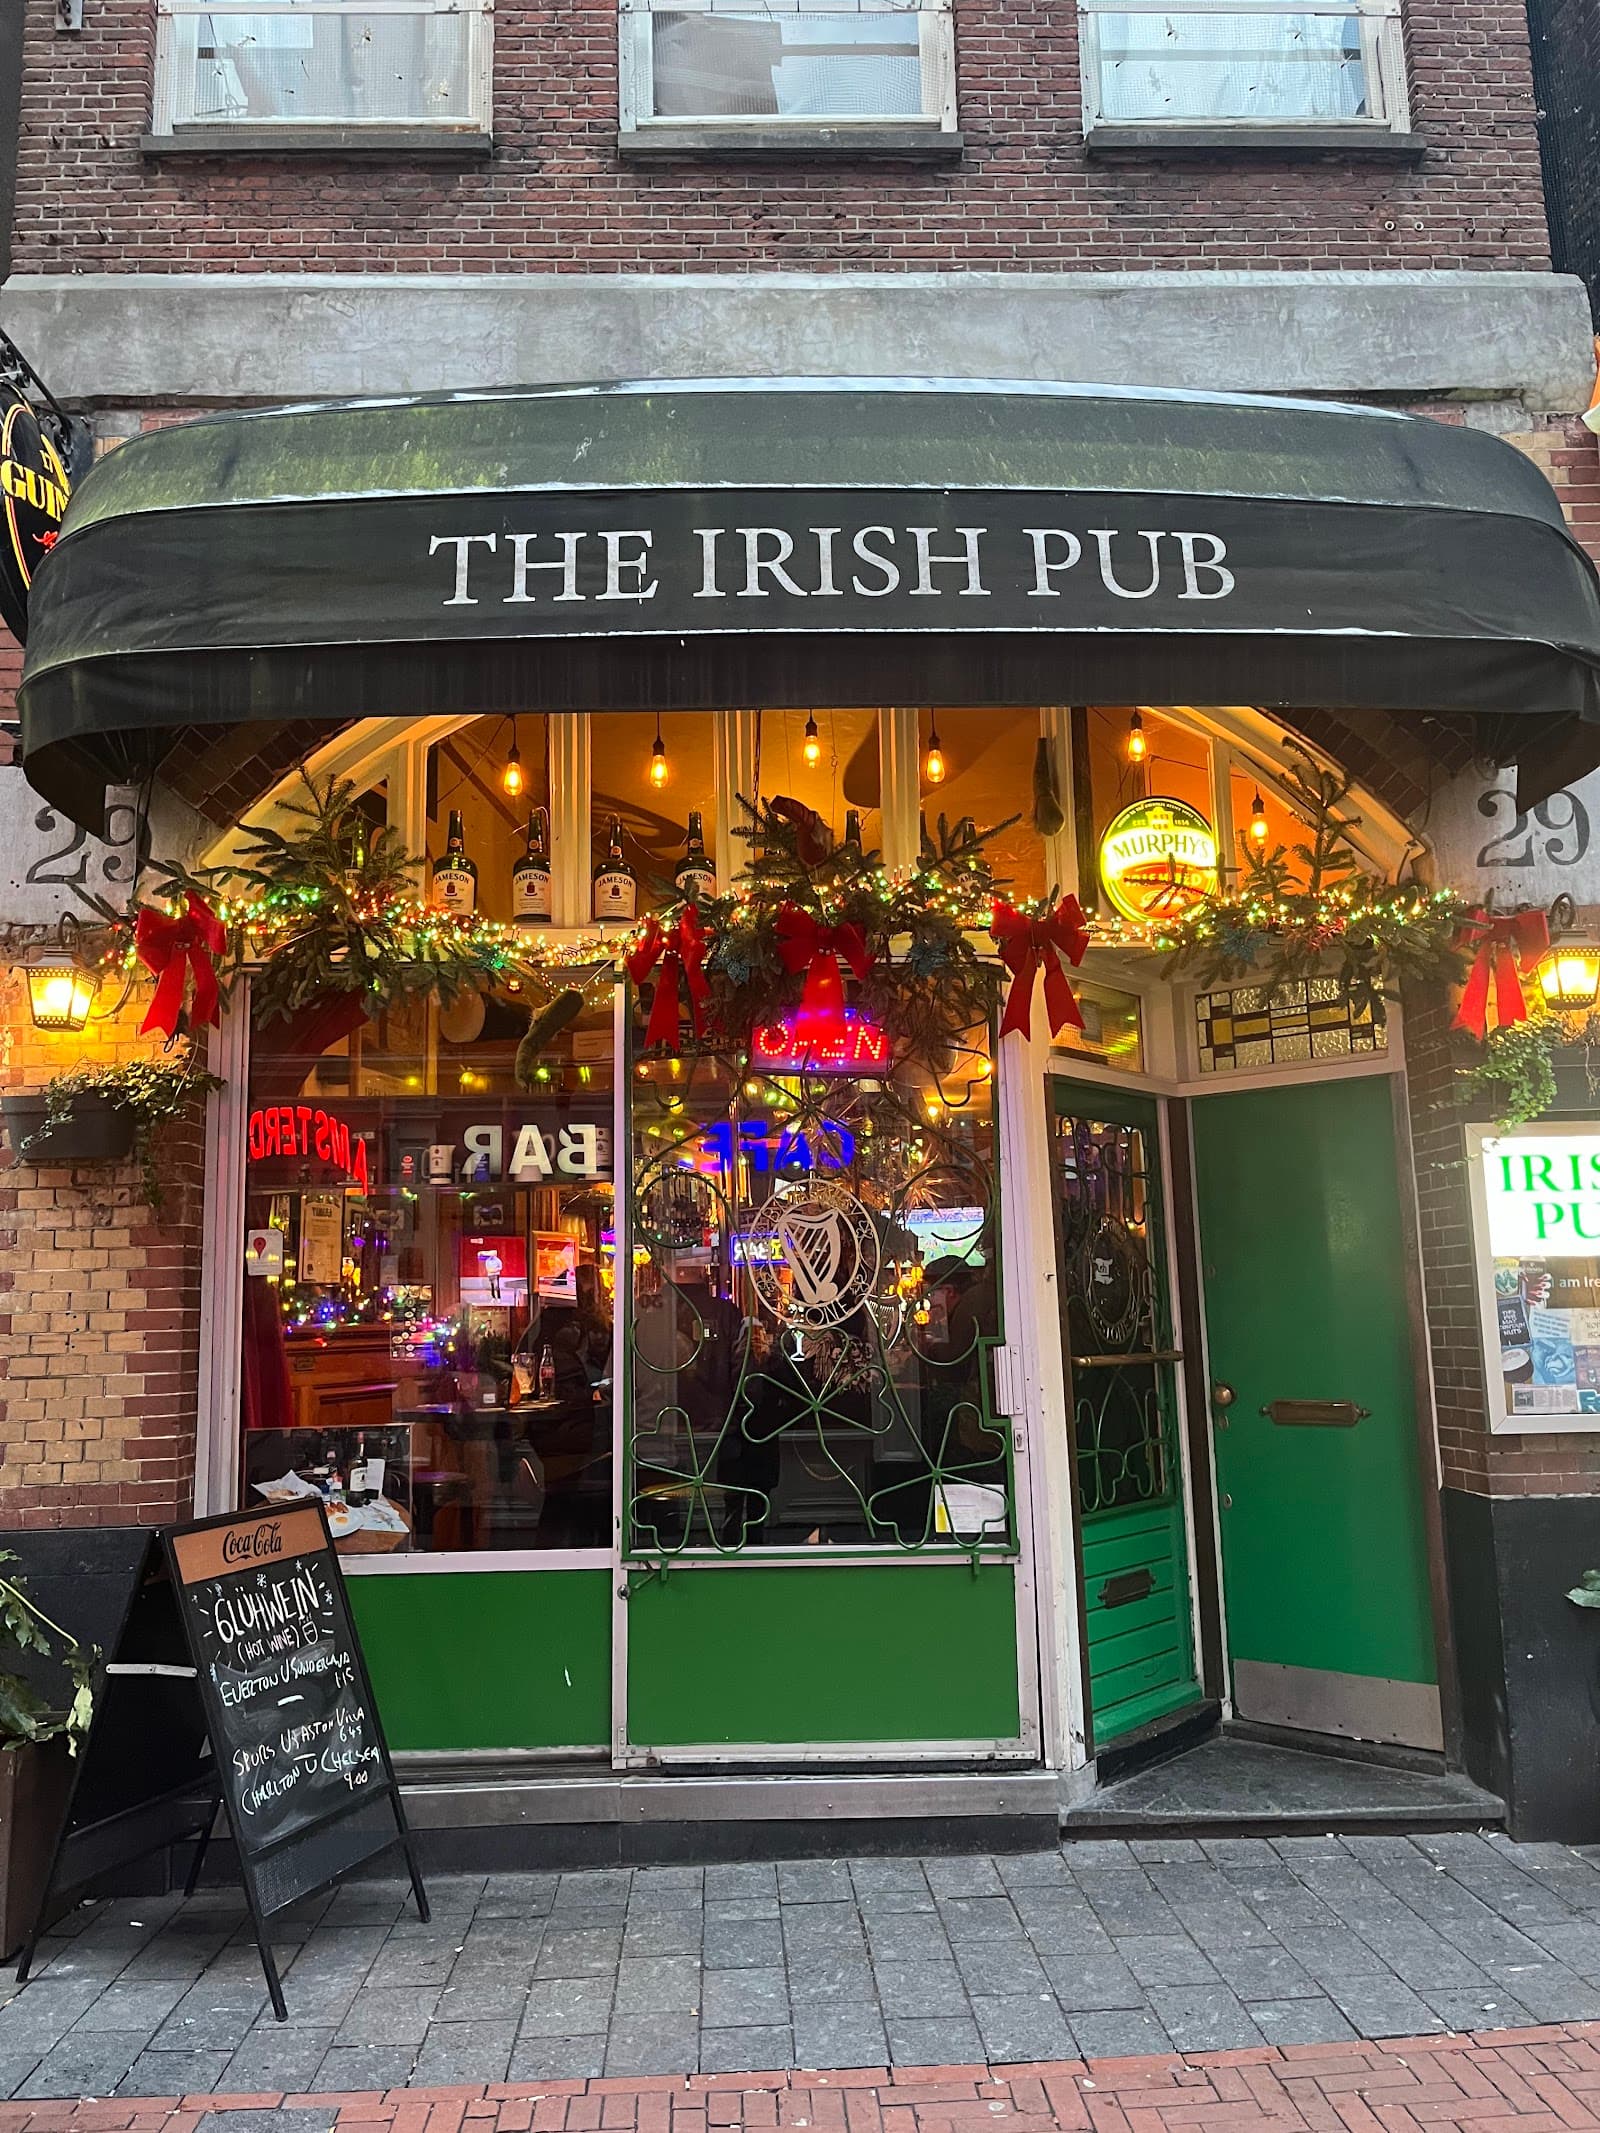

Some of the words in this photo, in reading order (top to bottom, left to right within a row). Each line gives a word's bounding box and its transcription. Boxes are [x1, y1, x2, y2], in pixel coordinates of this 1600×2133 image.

[428, 529, 659, 605] THE
[692, 526, 992, 597] IRISH
[1022, 528, 1235, 600] PUB
[1477, 788, 1590, 867] 29
[26, 803, 152, 884] 29
[434, 872, 469, 885] JAMESON
[514, 872, 549, 885] JAMESON
[598, 876, 632, 888] JAMESON
[1559, 1278, 1580, 1288] am
